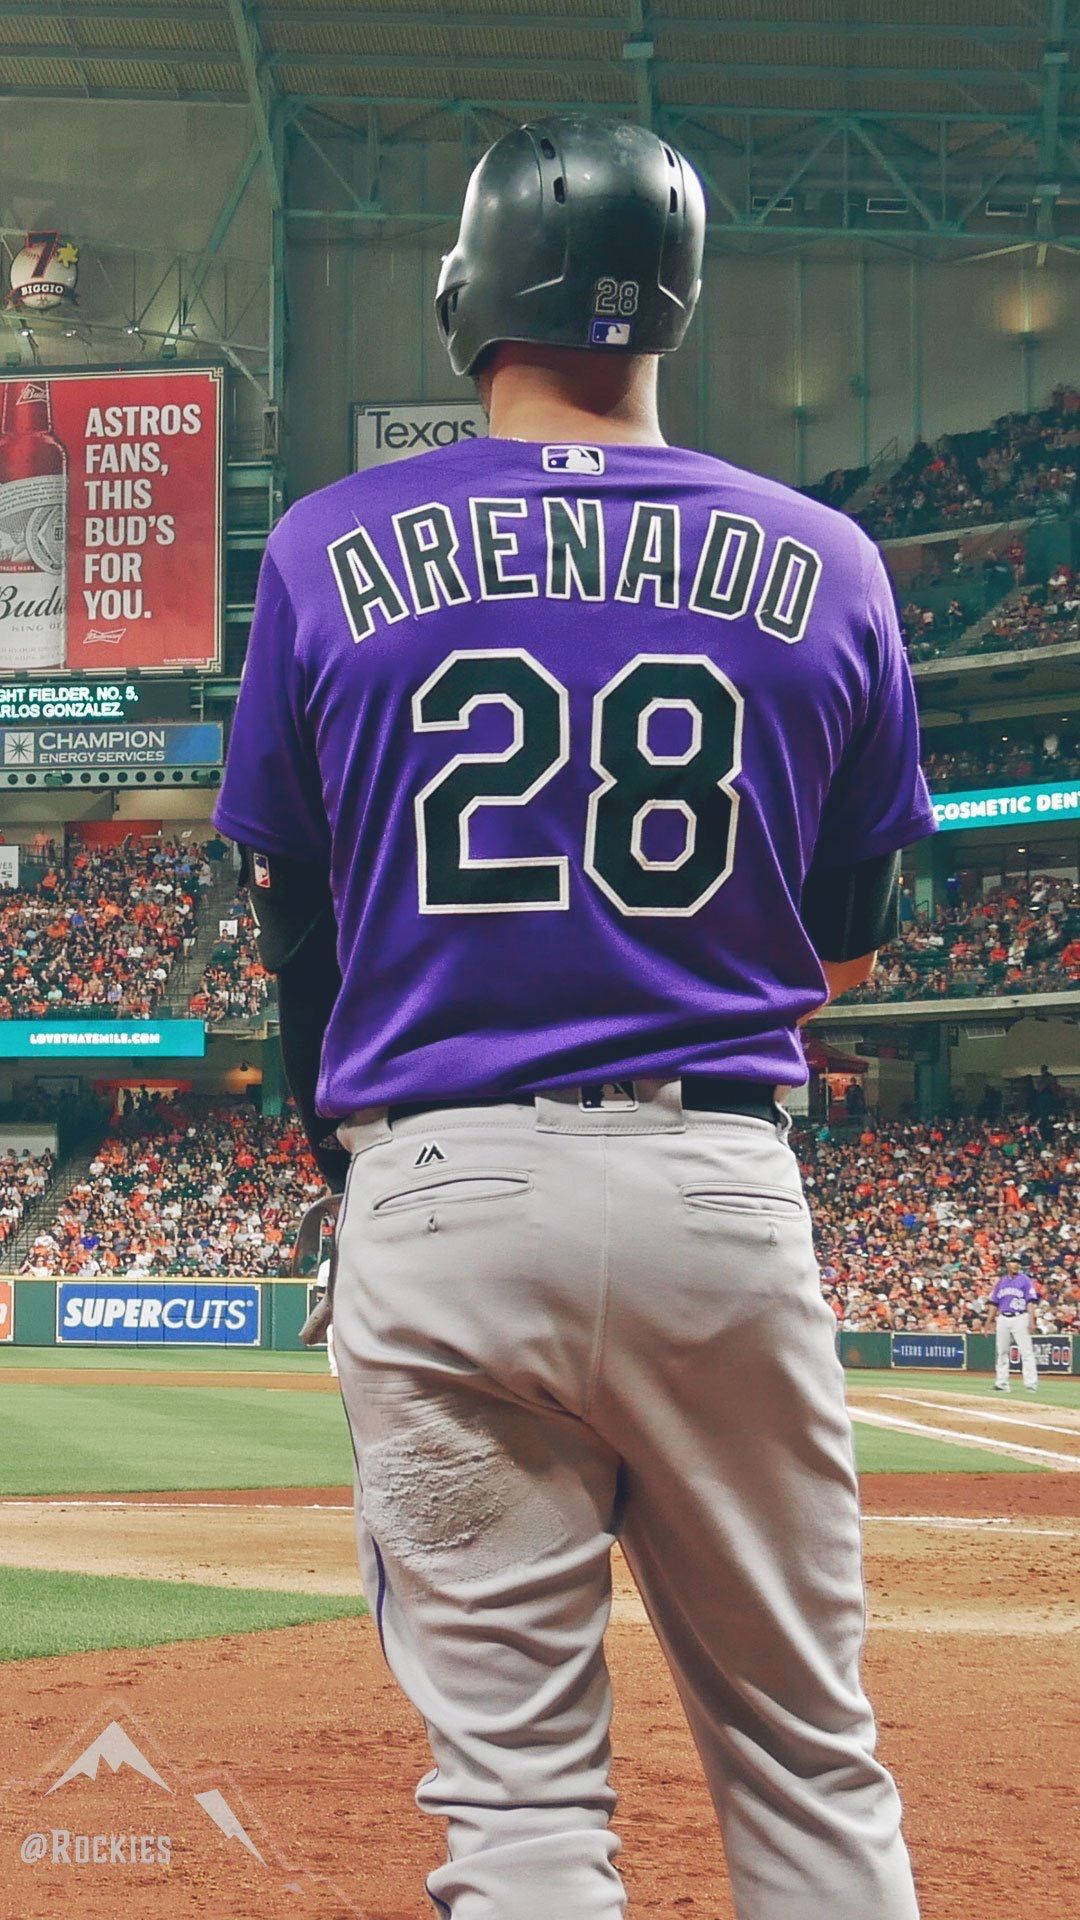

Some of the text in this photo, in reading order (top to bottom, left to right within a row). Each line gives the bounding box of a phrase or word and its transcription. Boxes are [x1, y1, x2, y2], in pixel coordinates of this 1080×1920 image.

[25, 230, 61, 279] 7
[20, 284, 64, 296] BIGGIO
[595, 277, 640, 316] 28
[85, 404, 201, 438] ASTROS
[367, 411, 478, 449] Texas
[85, 443, 169, 477] FANS,
[84, 479, 152, 510] THIS
[85, 515, 175, 547] BUD'S
[85, 552, 142, 584] FOR
[327, 496, 822, 644] ARENADO
[83, 589, 152, 620] YOU.
[0, 701, 125, 719] RLOS GONZALEZ.
[28, 687, 94, 703] FIELDER,
[96, 686, 123, 701] NO.
[38, 730, 165, 750] CHAMPION
[40, 750, 165, 764] ENERGY SERVICES
[412, 648, 744, 917] 28
[933, 789, 1080, 822] COSMETIC DEN
[925, 1346, 957, 1358] LOTTERY
